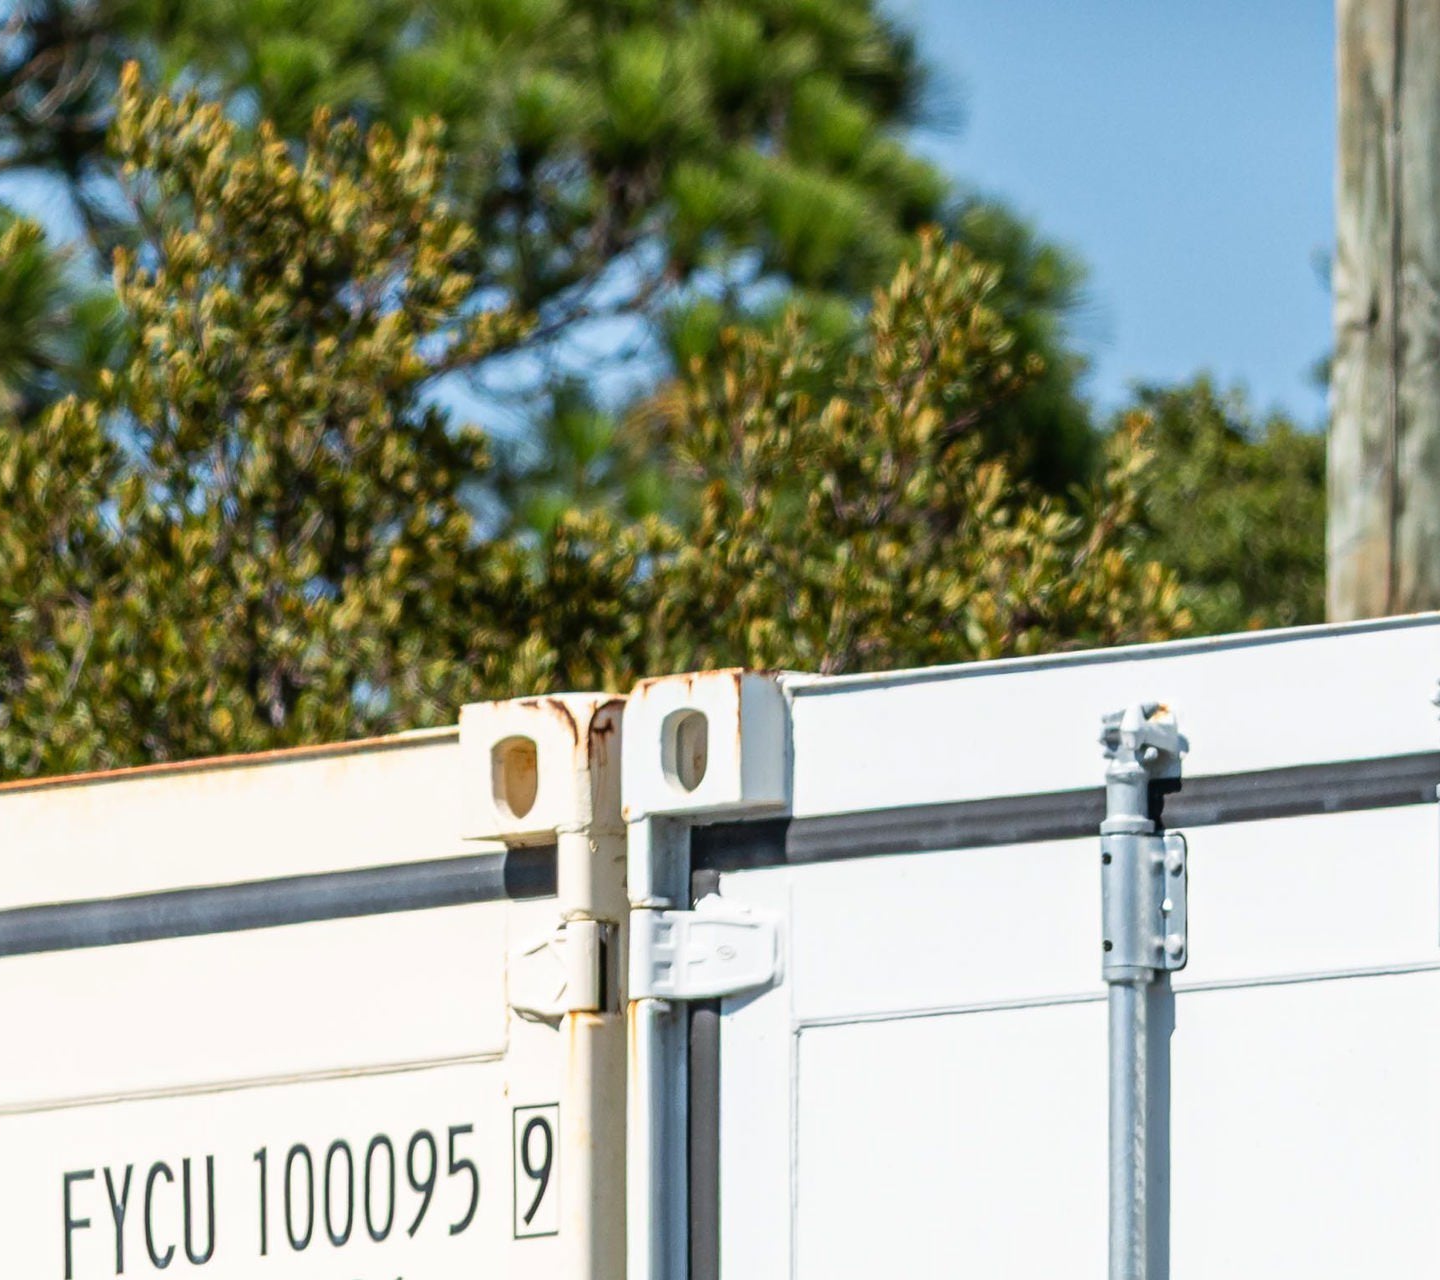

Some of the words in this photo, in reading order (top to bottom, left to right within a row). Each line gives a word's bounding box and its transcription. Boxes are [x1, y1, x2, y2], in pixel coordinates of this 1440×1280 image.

[63, 1155, 216, 1280] FYCU
[252, 1124, 480, 1256] 100095
[520, 1117, 553, 1225] 9
